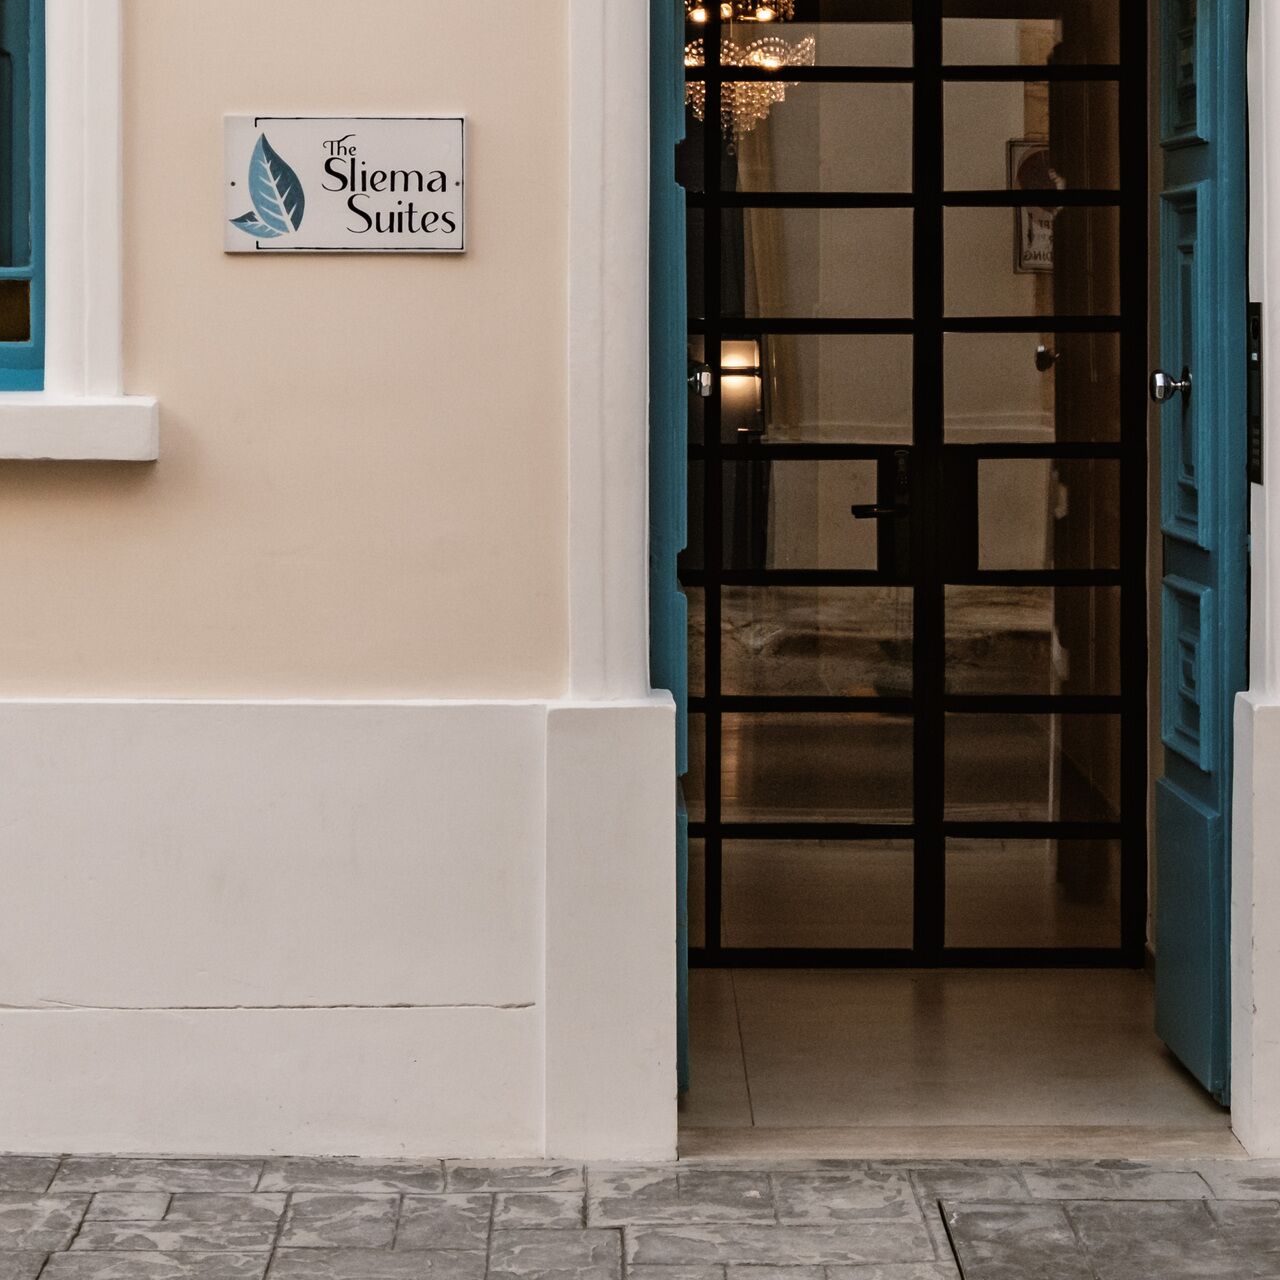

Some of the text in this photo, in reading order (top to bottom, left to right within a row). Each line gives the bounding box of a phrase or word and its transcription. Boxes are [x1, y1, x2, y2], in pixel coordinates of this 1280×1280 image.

[322, 134, 357, 156] The
[321, 157, 447, 192] Sliema
[346, 193, 456, 234] Suites
